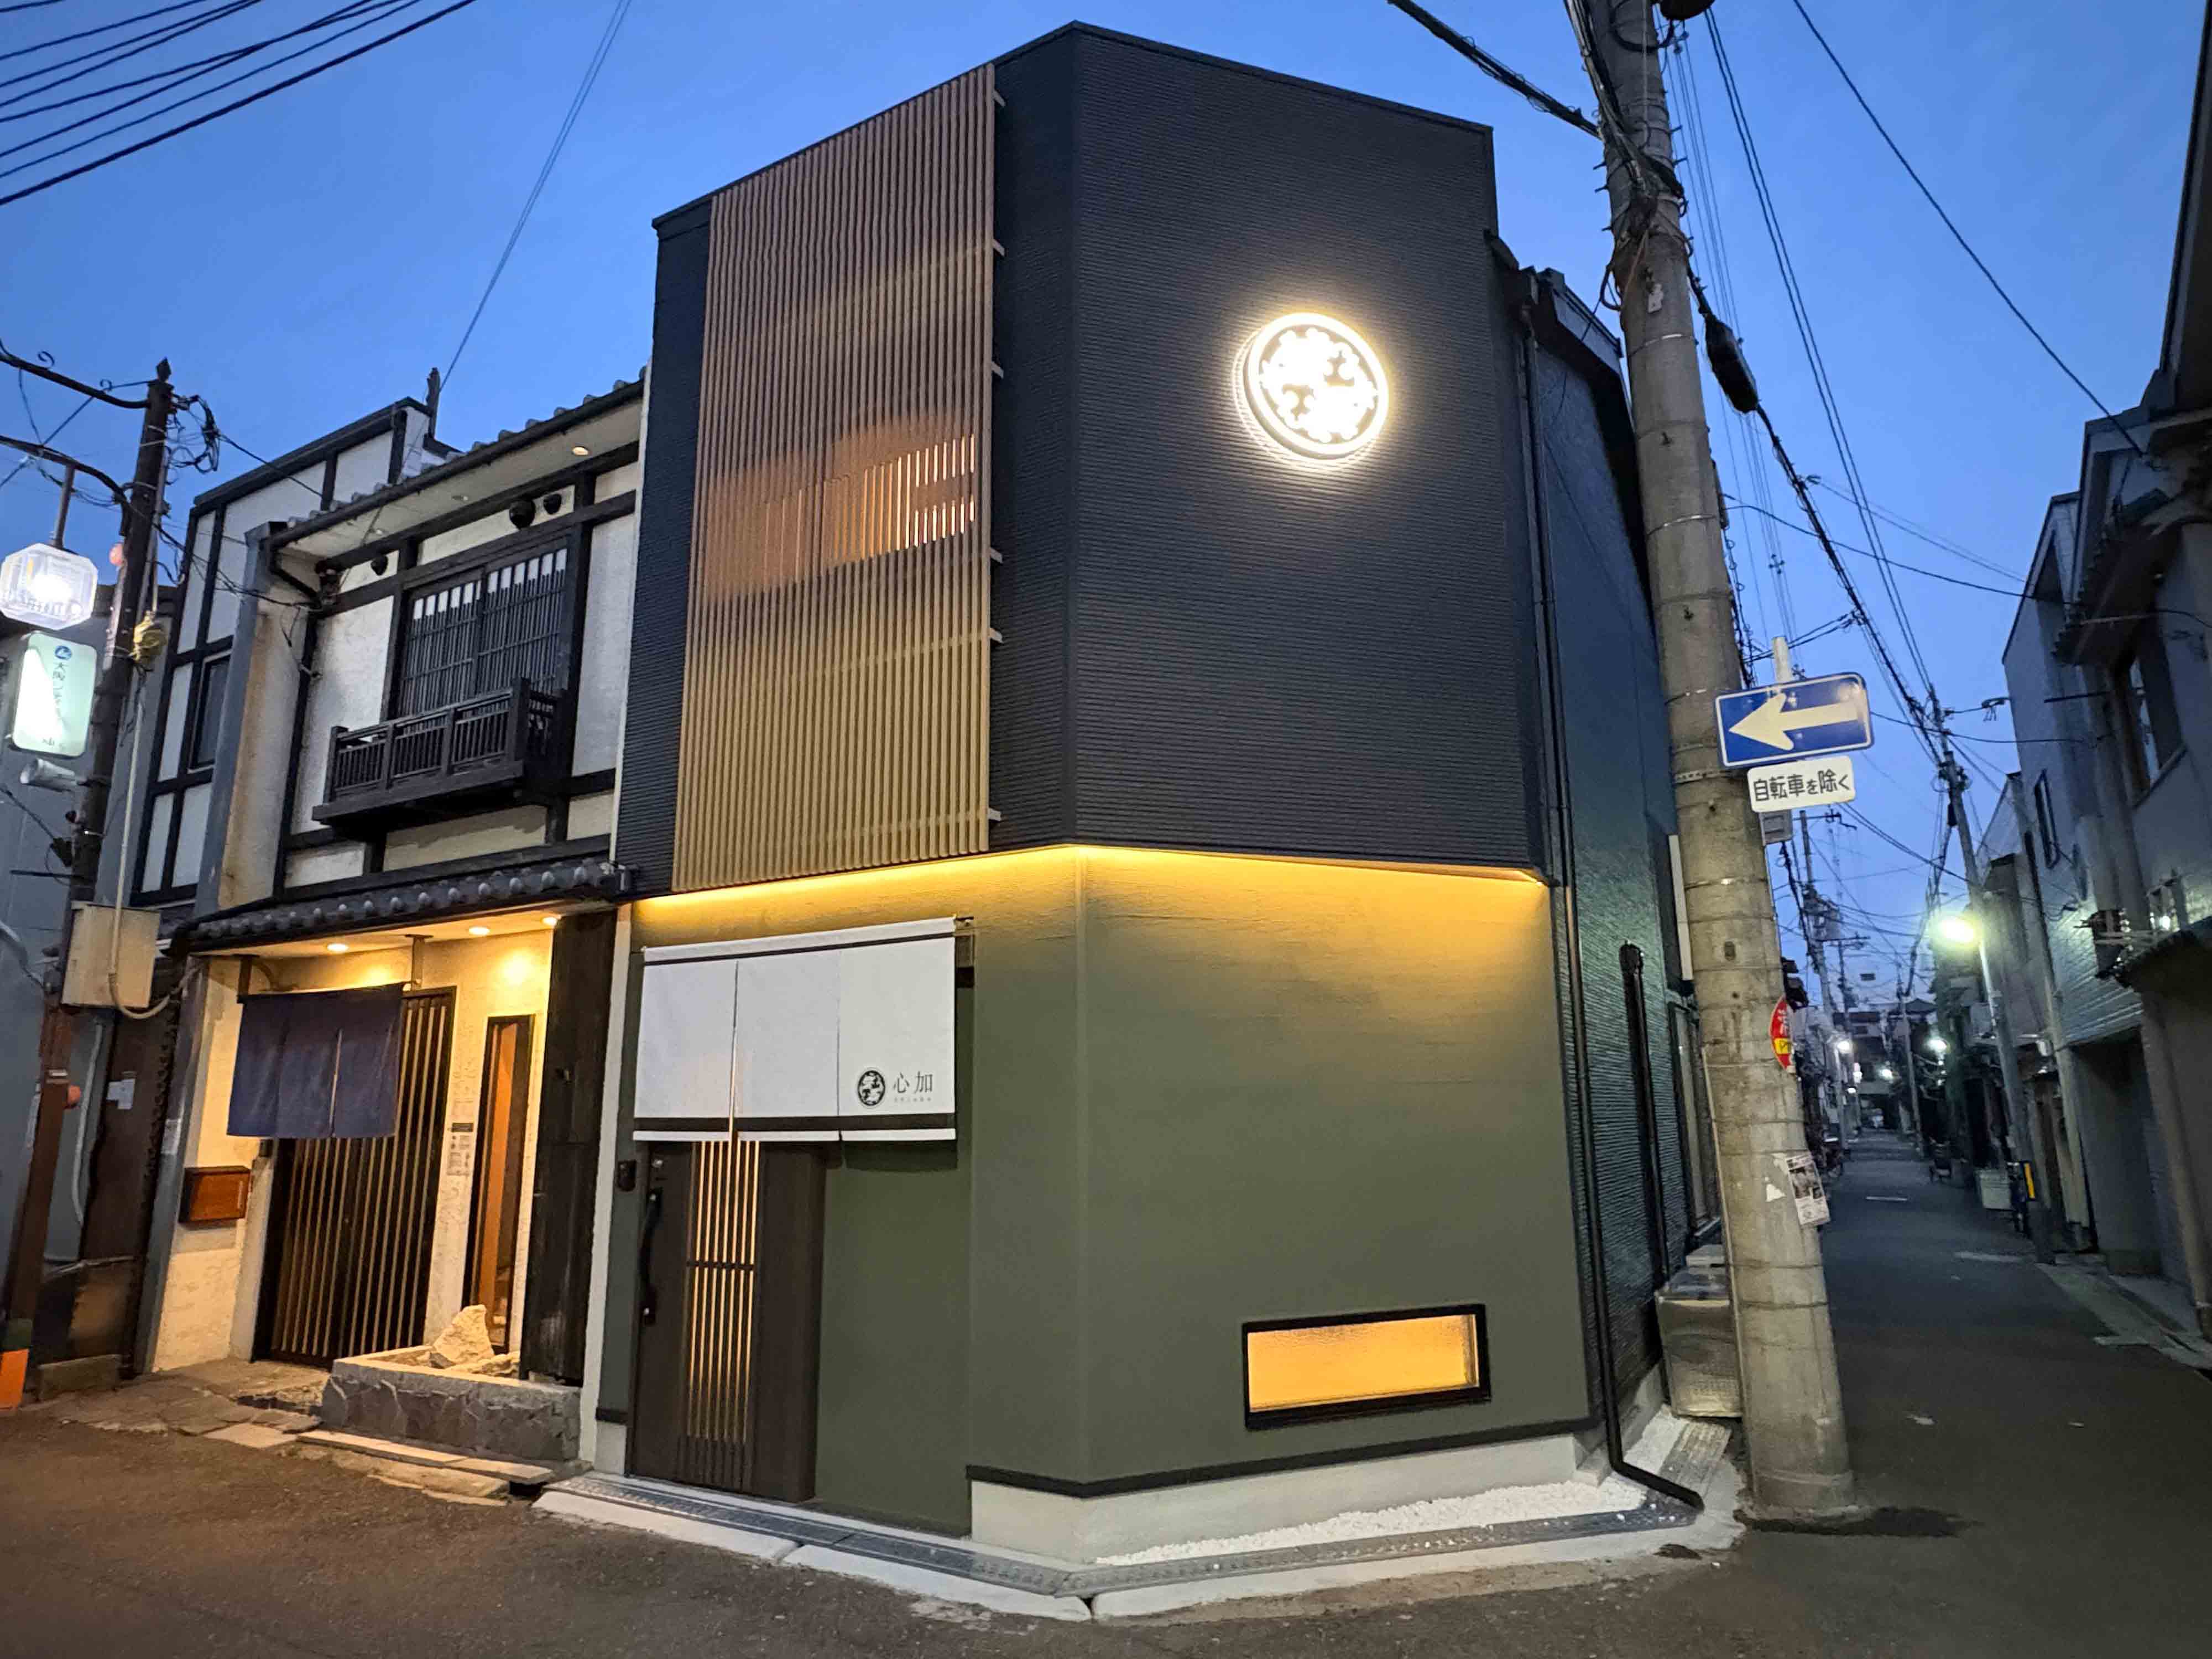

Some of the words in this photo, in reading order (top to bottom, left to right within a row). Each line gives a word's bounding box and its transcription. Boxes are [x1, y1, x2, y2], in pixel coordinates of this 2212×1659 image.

[1754, 769, 1850, 801] 自転車を除く
[893, 1071, 933, 1094] 心加
